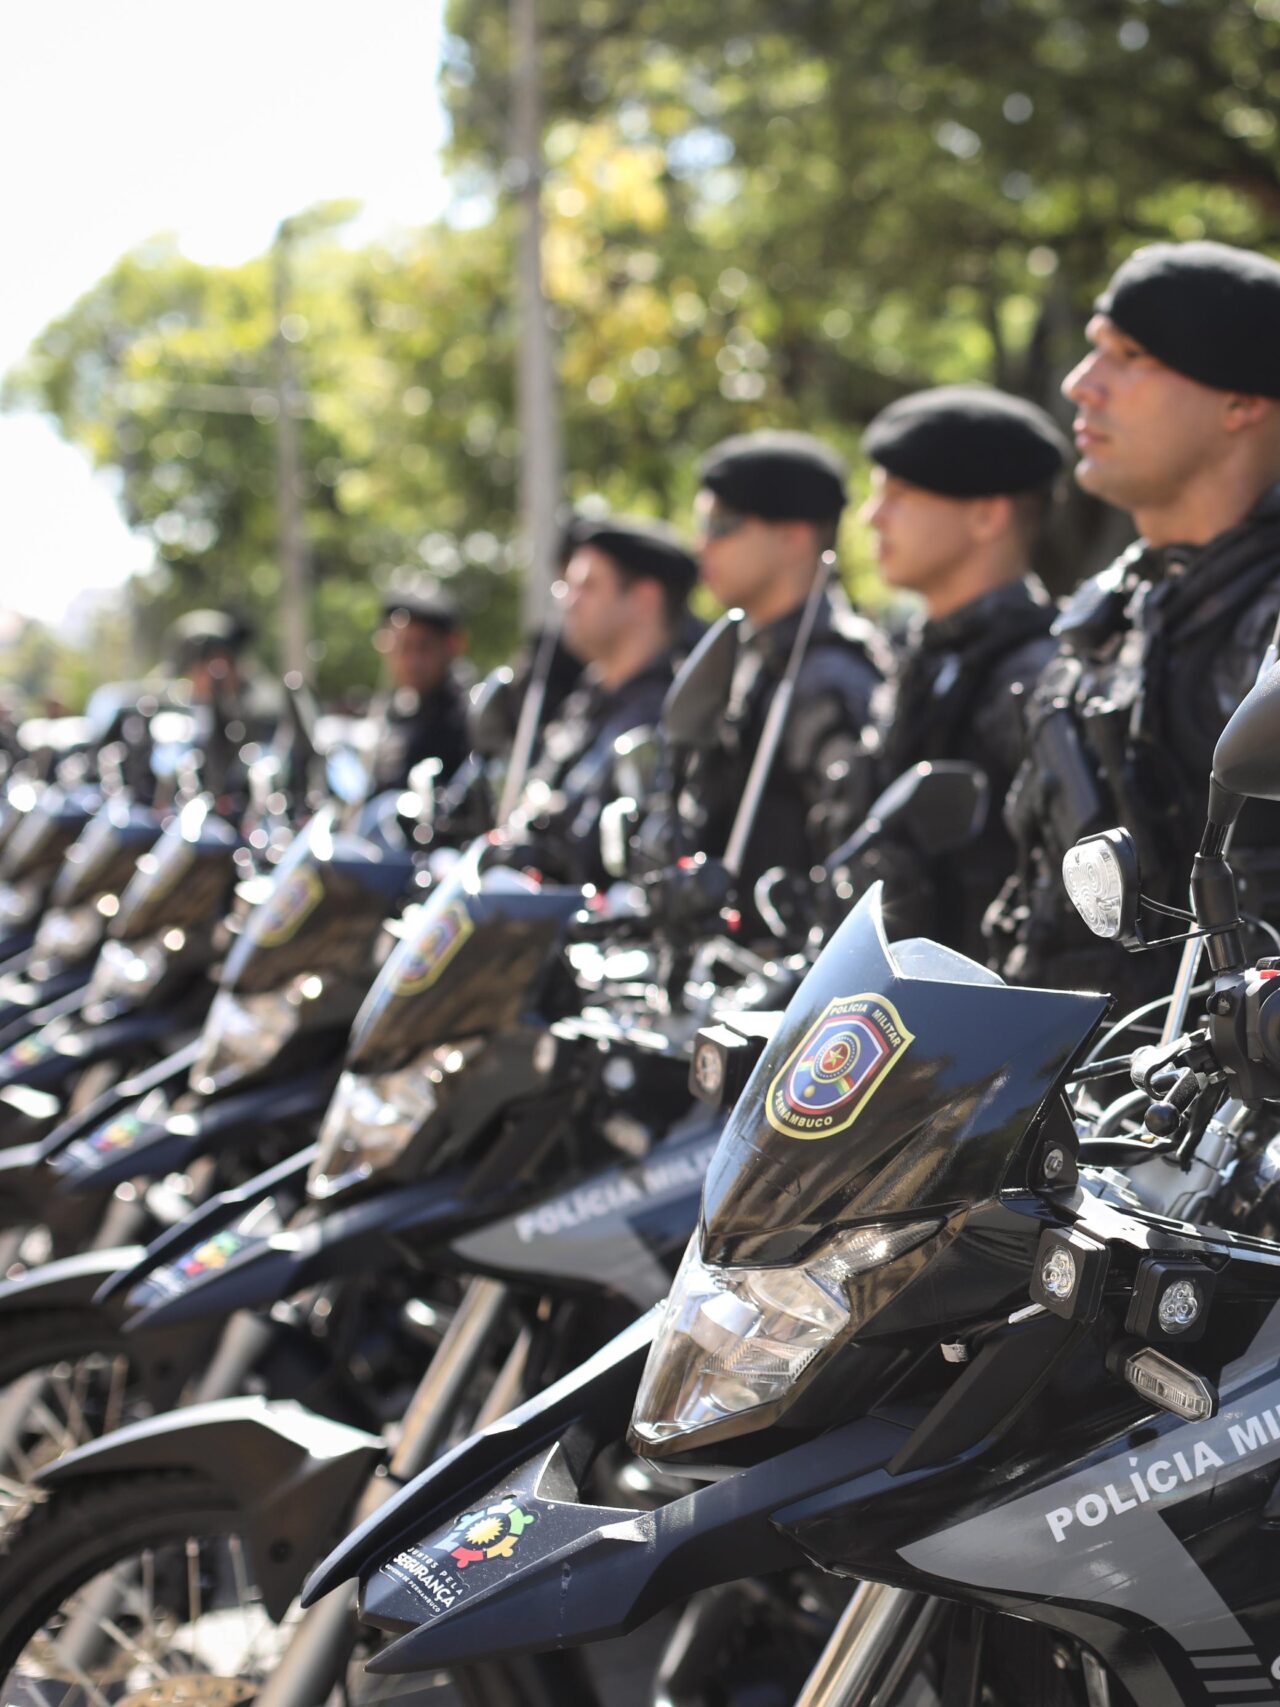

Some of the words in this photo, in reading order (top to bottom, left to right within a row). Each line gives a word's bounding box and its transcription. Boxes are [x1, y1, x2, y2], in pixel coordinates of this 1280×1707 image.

[872, 1009, 901, 1048] MILITAR
[775, 1089, 833, 1128] PERNAMBUCO
[1044, 1439, 1225, 1543] POLÍCIA
[393, 1552, 456, 1608] SEGURANÇA
[407, 1547, 439, 1569] JUNTOS
[439, 1570, 463, 1595] PELA
[408, 1580, 441, 1613] PERNAMBUCO
